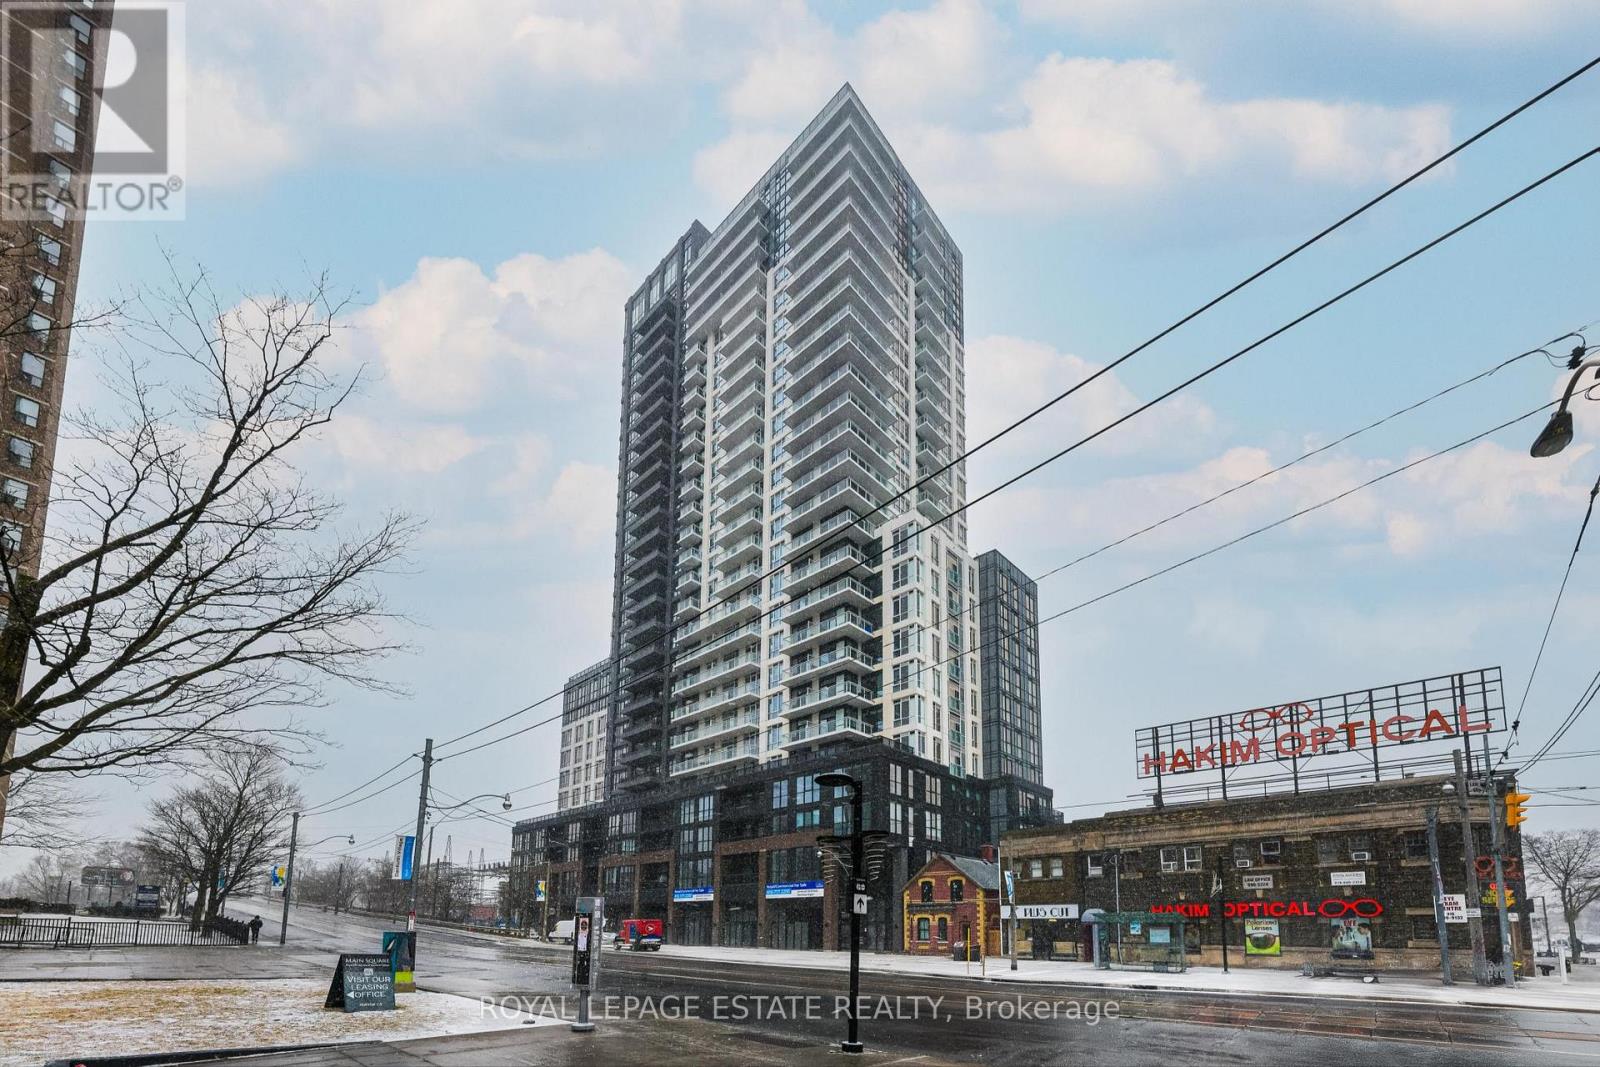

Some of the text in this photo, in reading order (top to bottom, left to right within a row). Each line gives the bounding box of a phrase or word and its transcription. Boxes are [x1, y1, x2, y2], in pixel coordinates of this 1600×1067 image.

[1144, 705, 1492, 775] HAKIM OPTICAL
[1151, 903, 1210, 917] HAKIM
[351, 983, 389, 991] LEASING
